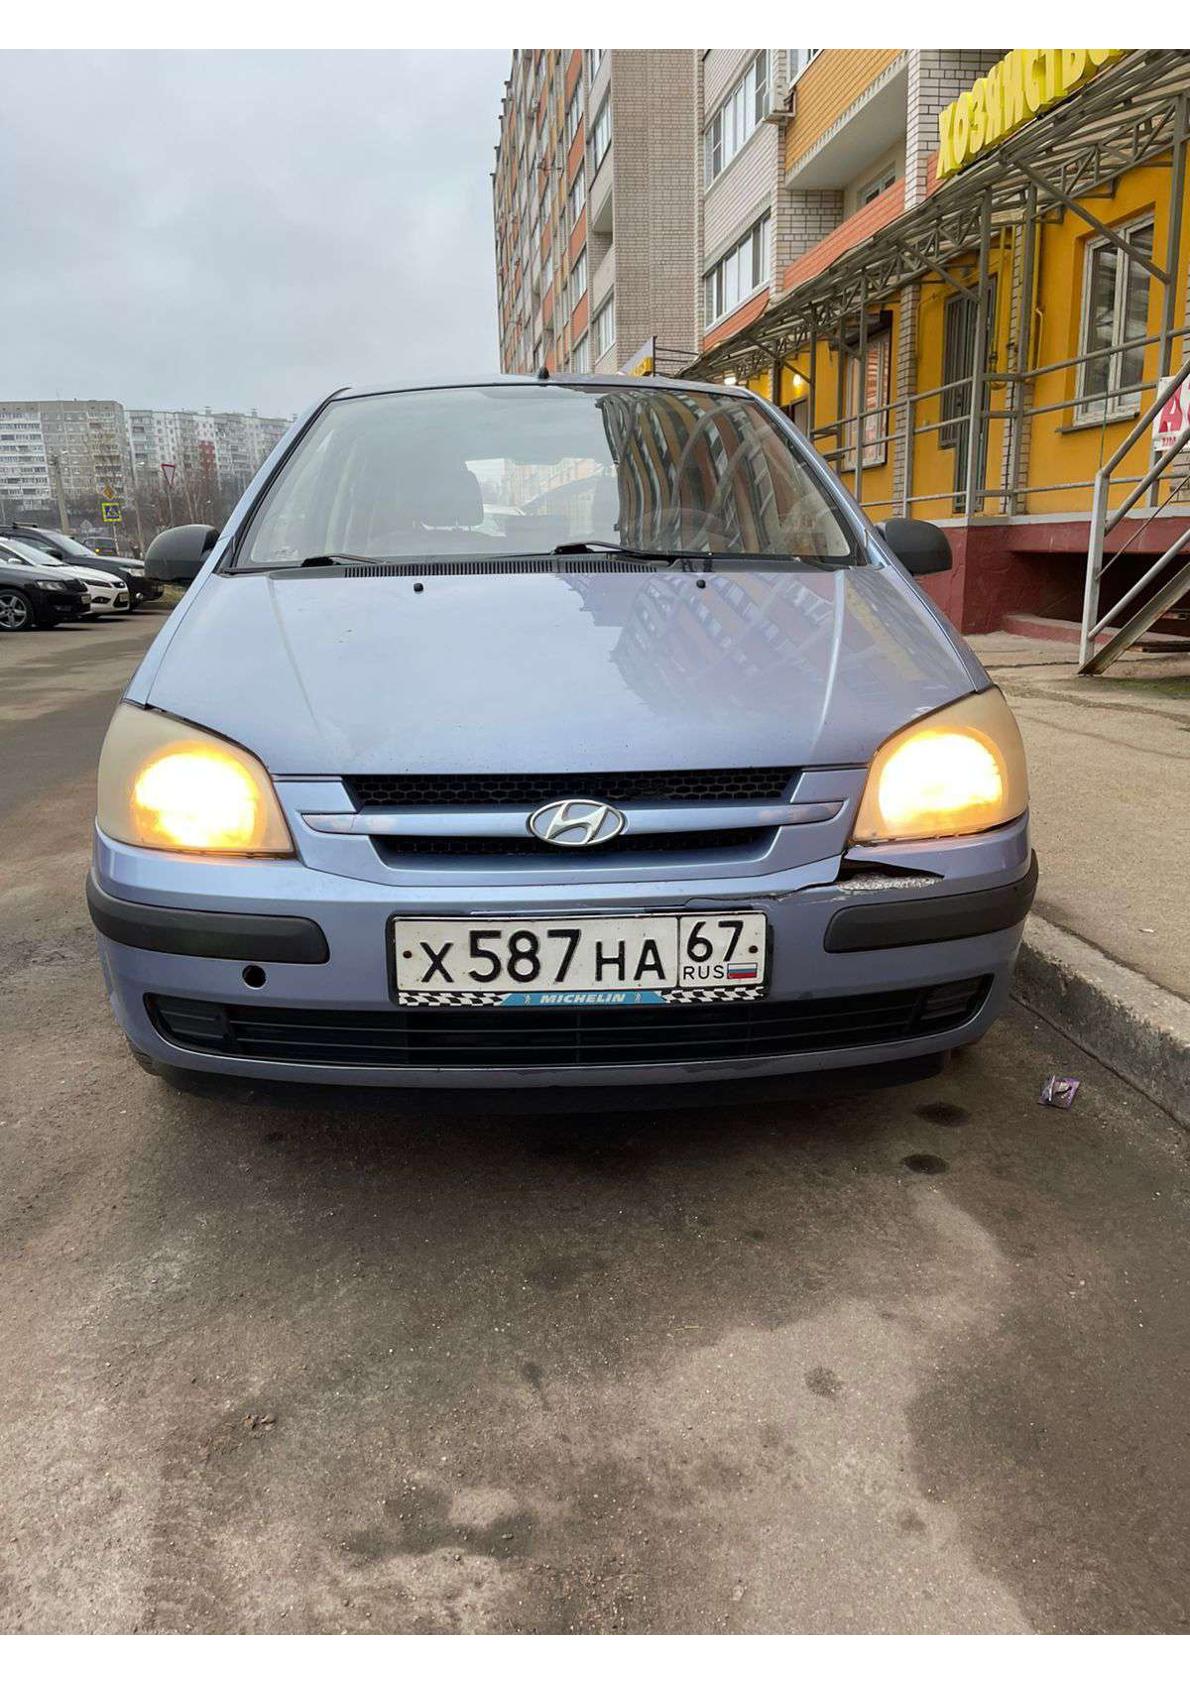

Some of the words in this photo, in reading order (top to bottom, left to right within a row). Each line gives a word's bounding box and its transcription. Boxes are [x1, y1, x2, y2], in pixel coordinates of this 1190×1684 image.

[686, 920, 744, 963] 67
[683, 963, 725, 980] RUS
[539, 993, 626, 1004] MICHELIN
